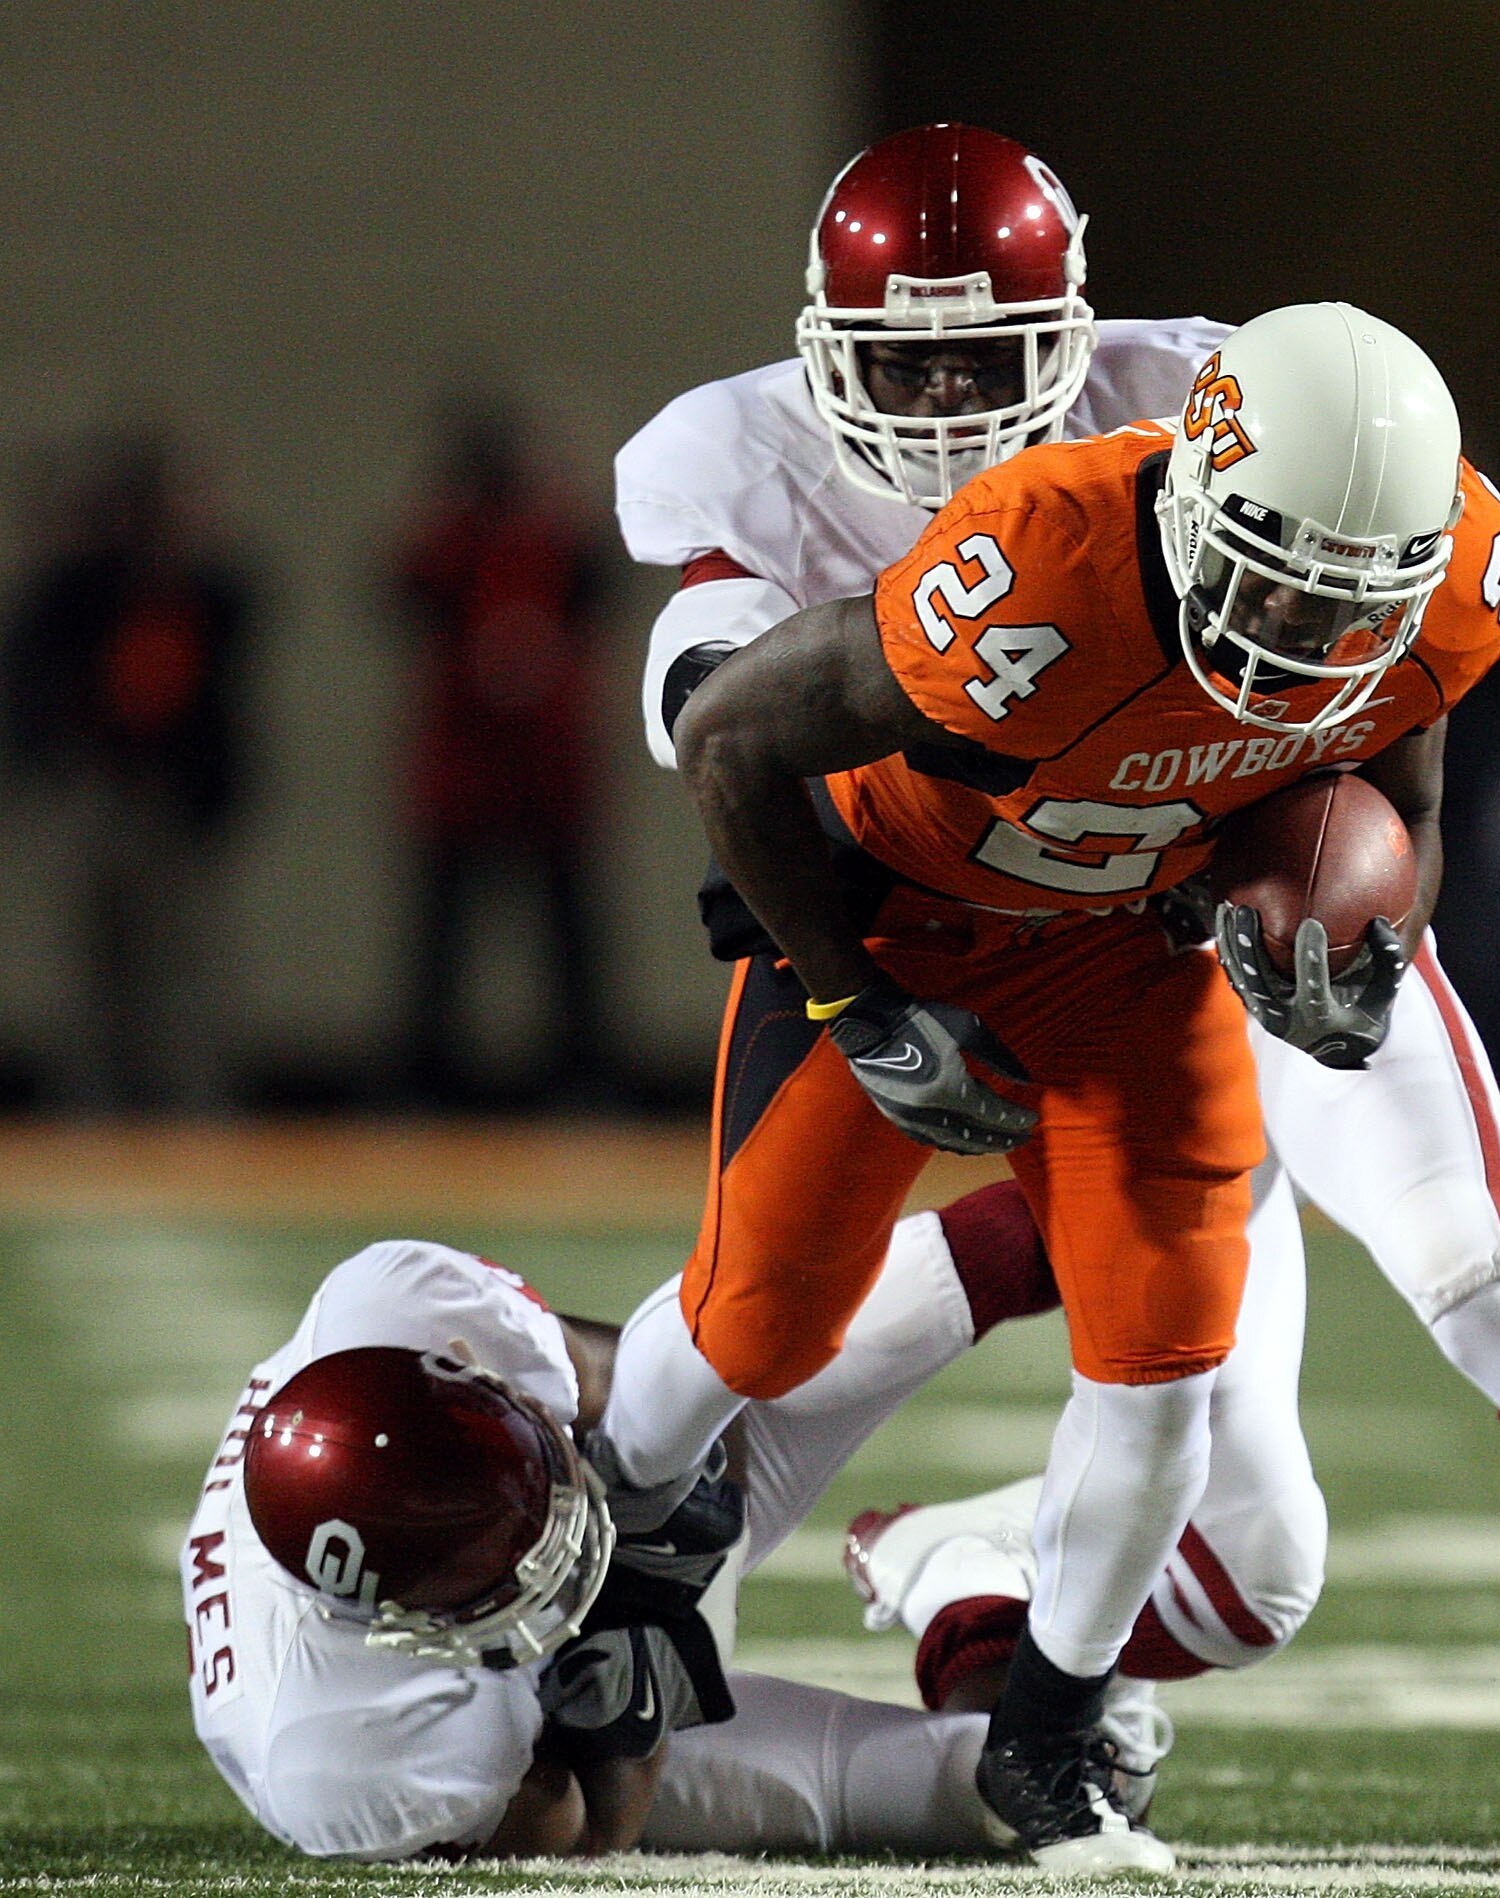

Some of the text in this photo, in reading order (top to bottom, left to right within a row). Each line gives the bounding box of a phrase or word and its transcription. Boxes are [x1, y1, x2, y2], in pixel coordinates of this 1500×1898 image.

[1183, 350, 1258, 473] OSU
[1239, 500, 1269, 522] NIKE
[912, 533, 1073, 722] 24
[1108, 720, 1376, 793] COWBOYS
